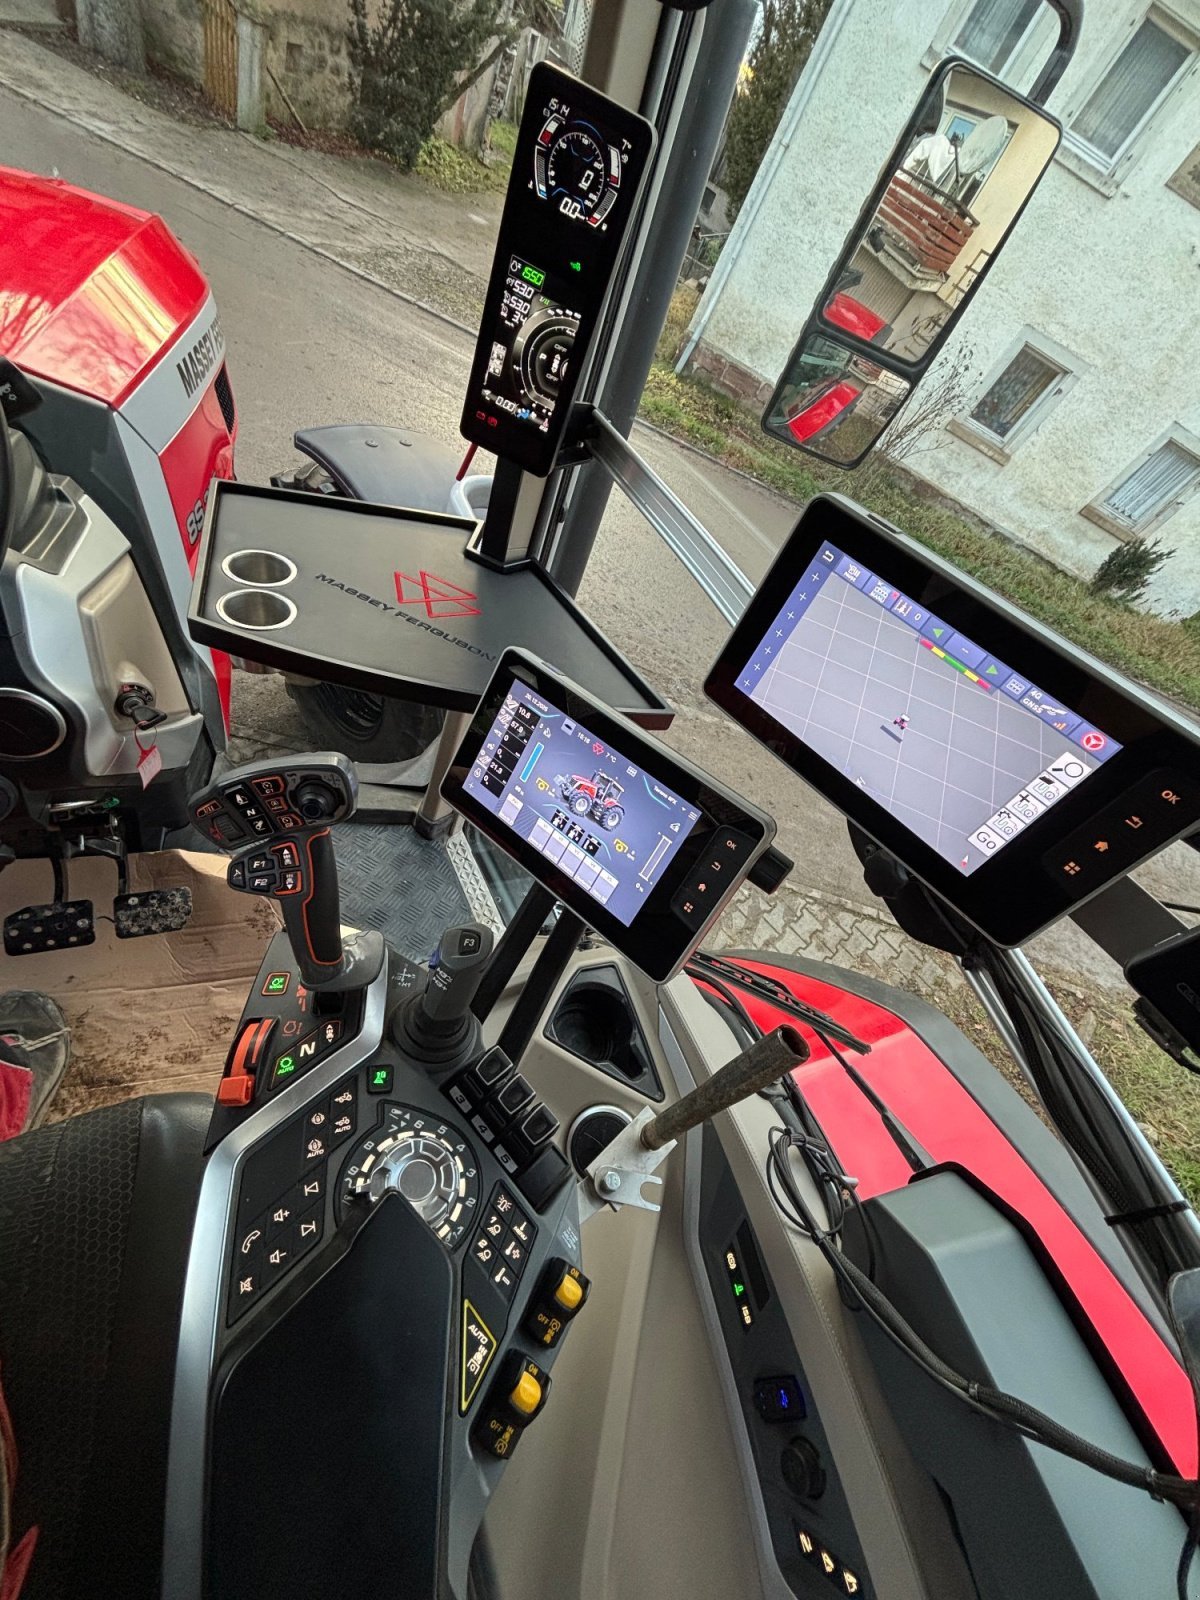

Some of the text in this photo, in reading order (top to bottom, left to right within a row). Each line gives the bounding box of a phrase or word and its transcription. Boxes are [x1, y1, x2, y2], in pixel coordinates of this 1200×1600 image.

[176, 328, 216, 399] MASSEY
[315, 573, 497, 662] MASSEY FERGUSON
[1022, 697, 1045, 714] GNSS
[1161, 789, 1182, 805] OK
[246, 808, 256, 817] N
[726, 839, 738, 851] OK
[976, 831, 997, 850] Go
[253, 860, 266, 869] F1
[254, 878, 268, 886] F2
[463, 938, 475, 947] F3
[300, 1041, 316, 1058] N
[277, 1065, 295, 1075] AUTO
[456, 1094, 464, 1104] 3
[334, 1125, 351, 1134] AUTO
[387, 1123, 399, 1134] 7
[414, 1120, 425, 1129] 6
[478, 1124, 487, 1134] 4
[437, 1126, 448, 1134] 5
[363, 1141, 375, 1151] 8
[456, 1144, 467, 1152] 4
[307, 1148, 325, 1159] AUTO
[500, 1154, 510, 1164] 5
[466, 1168, 477, 1178] 3
[465, 1197, 476, 1208] 2
[490, 1216, 497, 1224] 1
[512, 1226, 528, 1241] MENU
[478, 1239, 488, 1249] 2
[570, 1268, 580, 1279] ON
[537, 1313, 549, 1325] OFF
[468, 1324, 489, 1345] AUTO
[528, 1364, 539, 1377] ON
[490, 1419, 503, 1432] OFF
